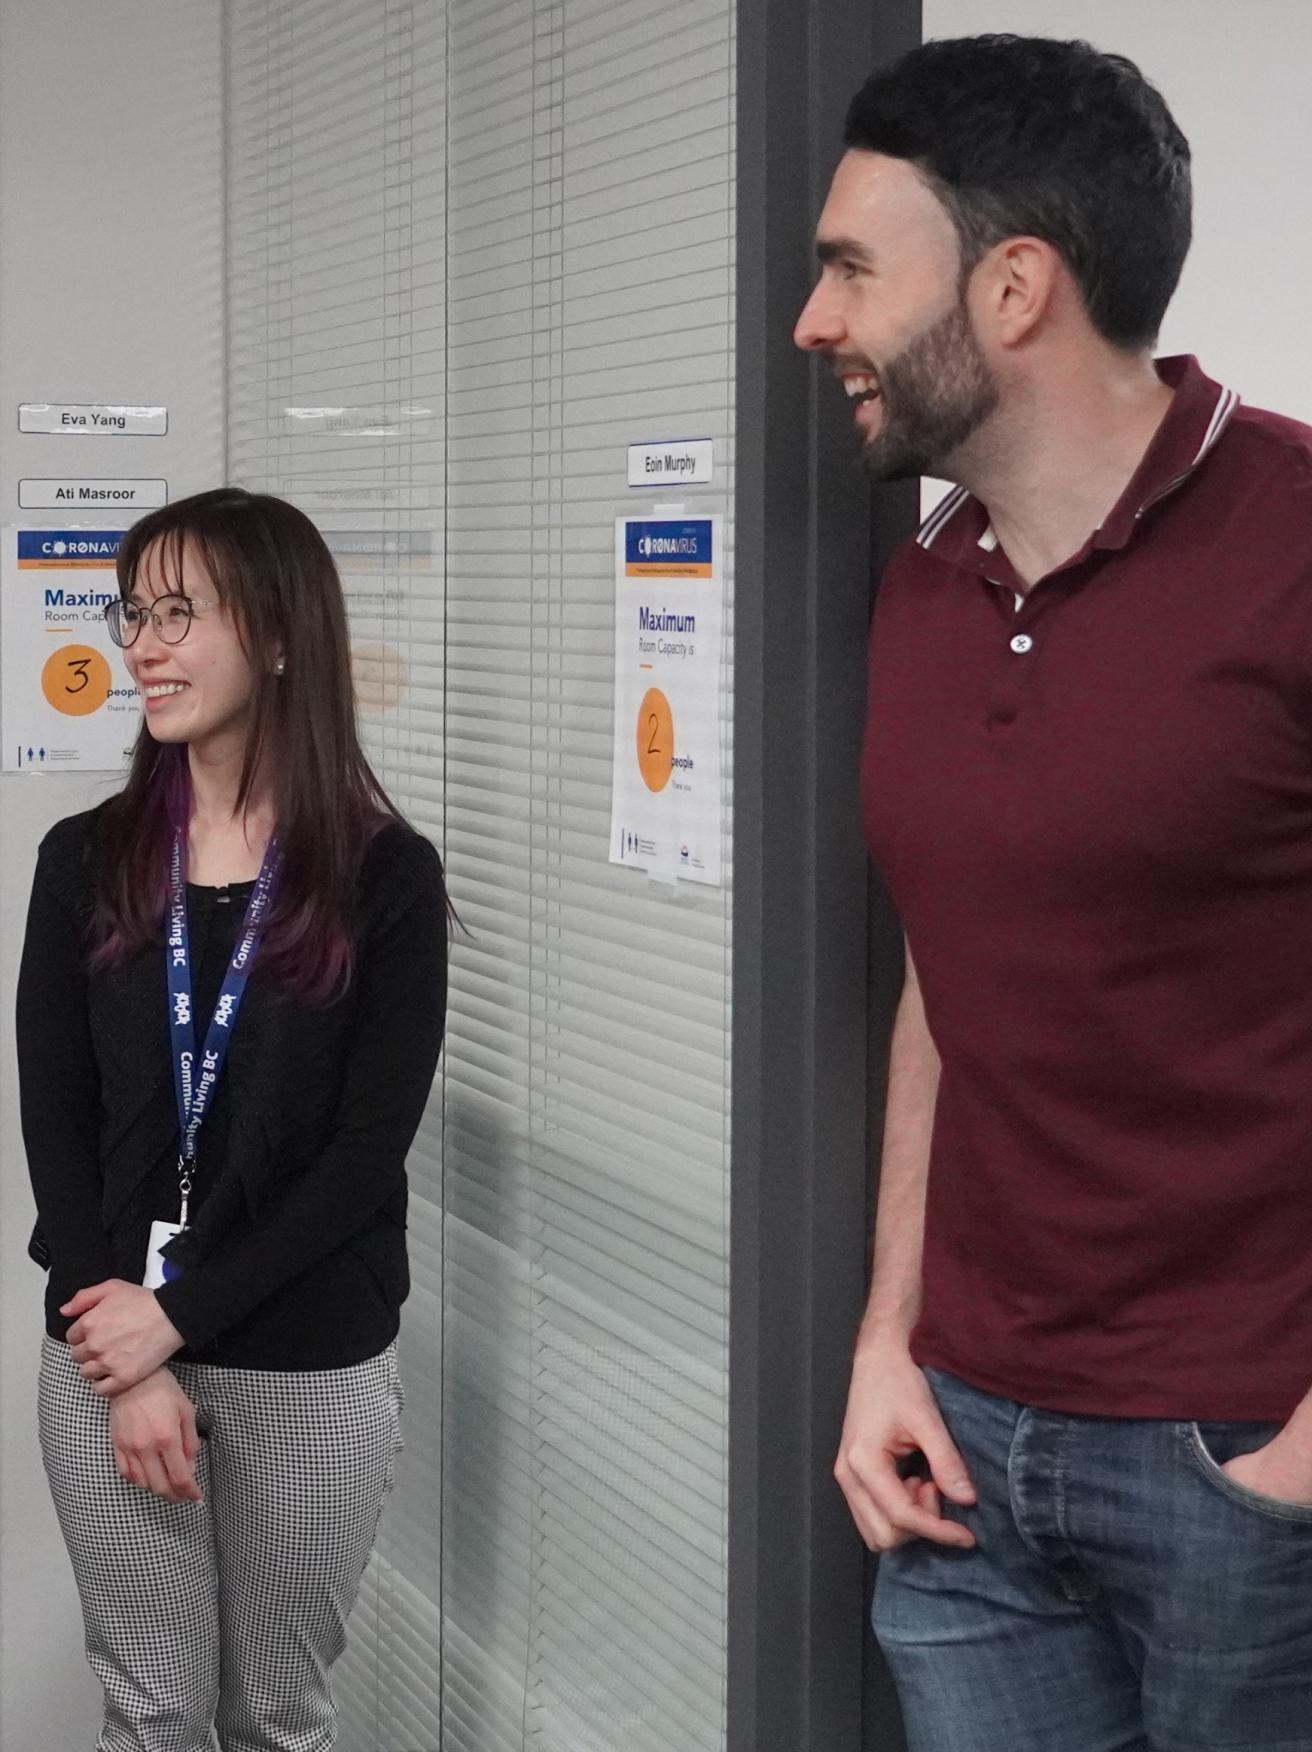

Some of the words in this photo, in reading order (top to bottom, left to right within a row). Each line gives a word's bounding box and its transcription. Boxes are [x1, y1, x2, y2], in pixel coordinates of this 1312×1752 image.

[61, 413, 87, 425] Eva
[91, 414, 126, 428] Yang
[645, 456, 662, 473] Eoin
[664, 454, 696, 475] Murphy
[55, 488, 74, 500] Ati
[79, 488, 135, 500] Masroor
[42, 540, 120, 555] CORONAVI
[45, 610, 79, 621] Room
[82, 610, 106, 623] Cap
[639, 606, 696, 633] Maximum
[639, 637, 656, 653] Room
[658, 638, 687, 659] Capacity
[688, 642, 694, 656] is
[65, 659, 92, 693] 3
[647, 713, 661, 754] 2
[168, 905, 184, 946] Living
[173, 948, 186, 967] BC
[202, 1050, 219, 1070] BC
[191, 1071, 216, 1113] Living
